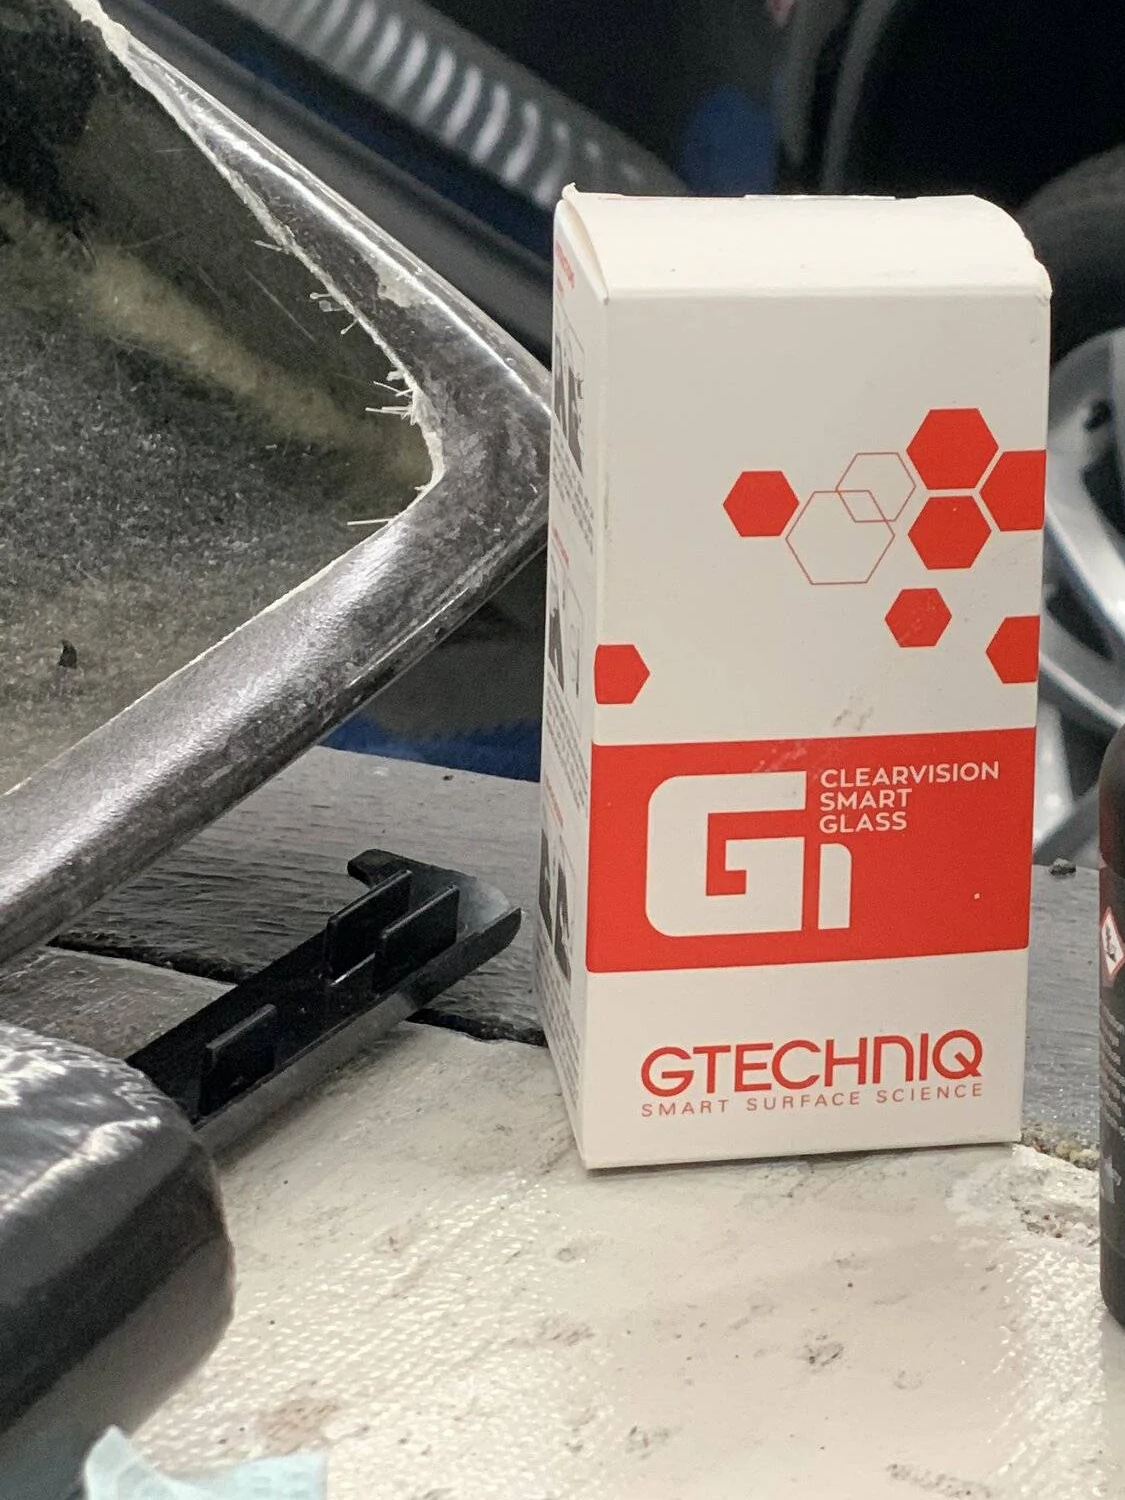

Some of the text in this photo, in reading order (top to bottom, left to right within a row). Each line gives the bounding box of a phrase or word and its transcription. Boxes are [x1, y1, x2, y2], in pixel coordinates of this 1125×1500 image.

[820, 761, 999, 788] CLEARVISION
[820, 788, 912, 812] SMART
[819, 811, 907, 834] GLASS
[641, 1029, 983, 1098] GTECHNIQ
[641, 1082, 983, 1118] SMART SURFACE SCIENCE
